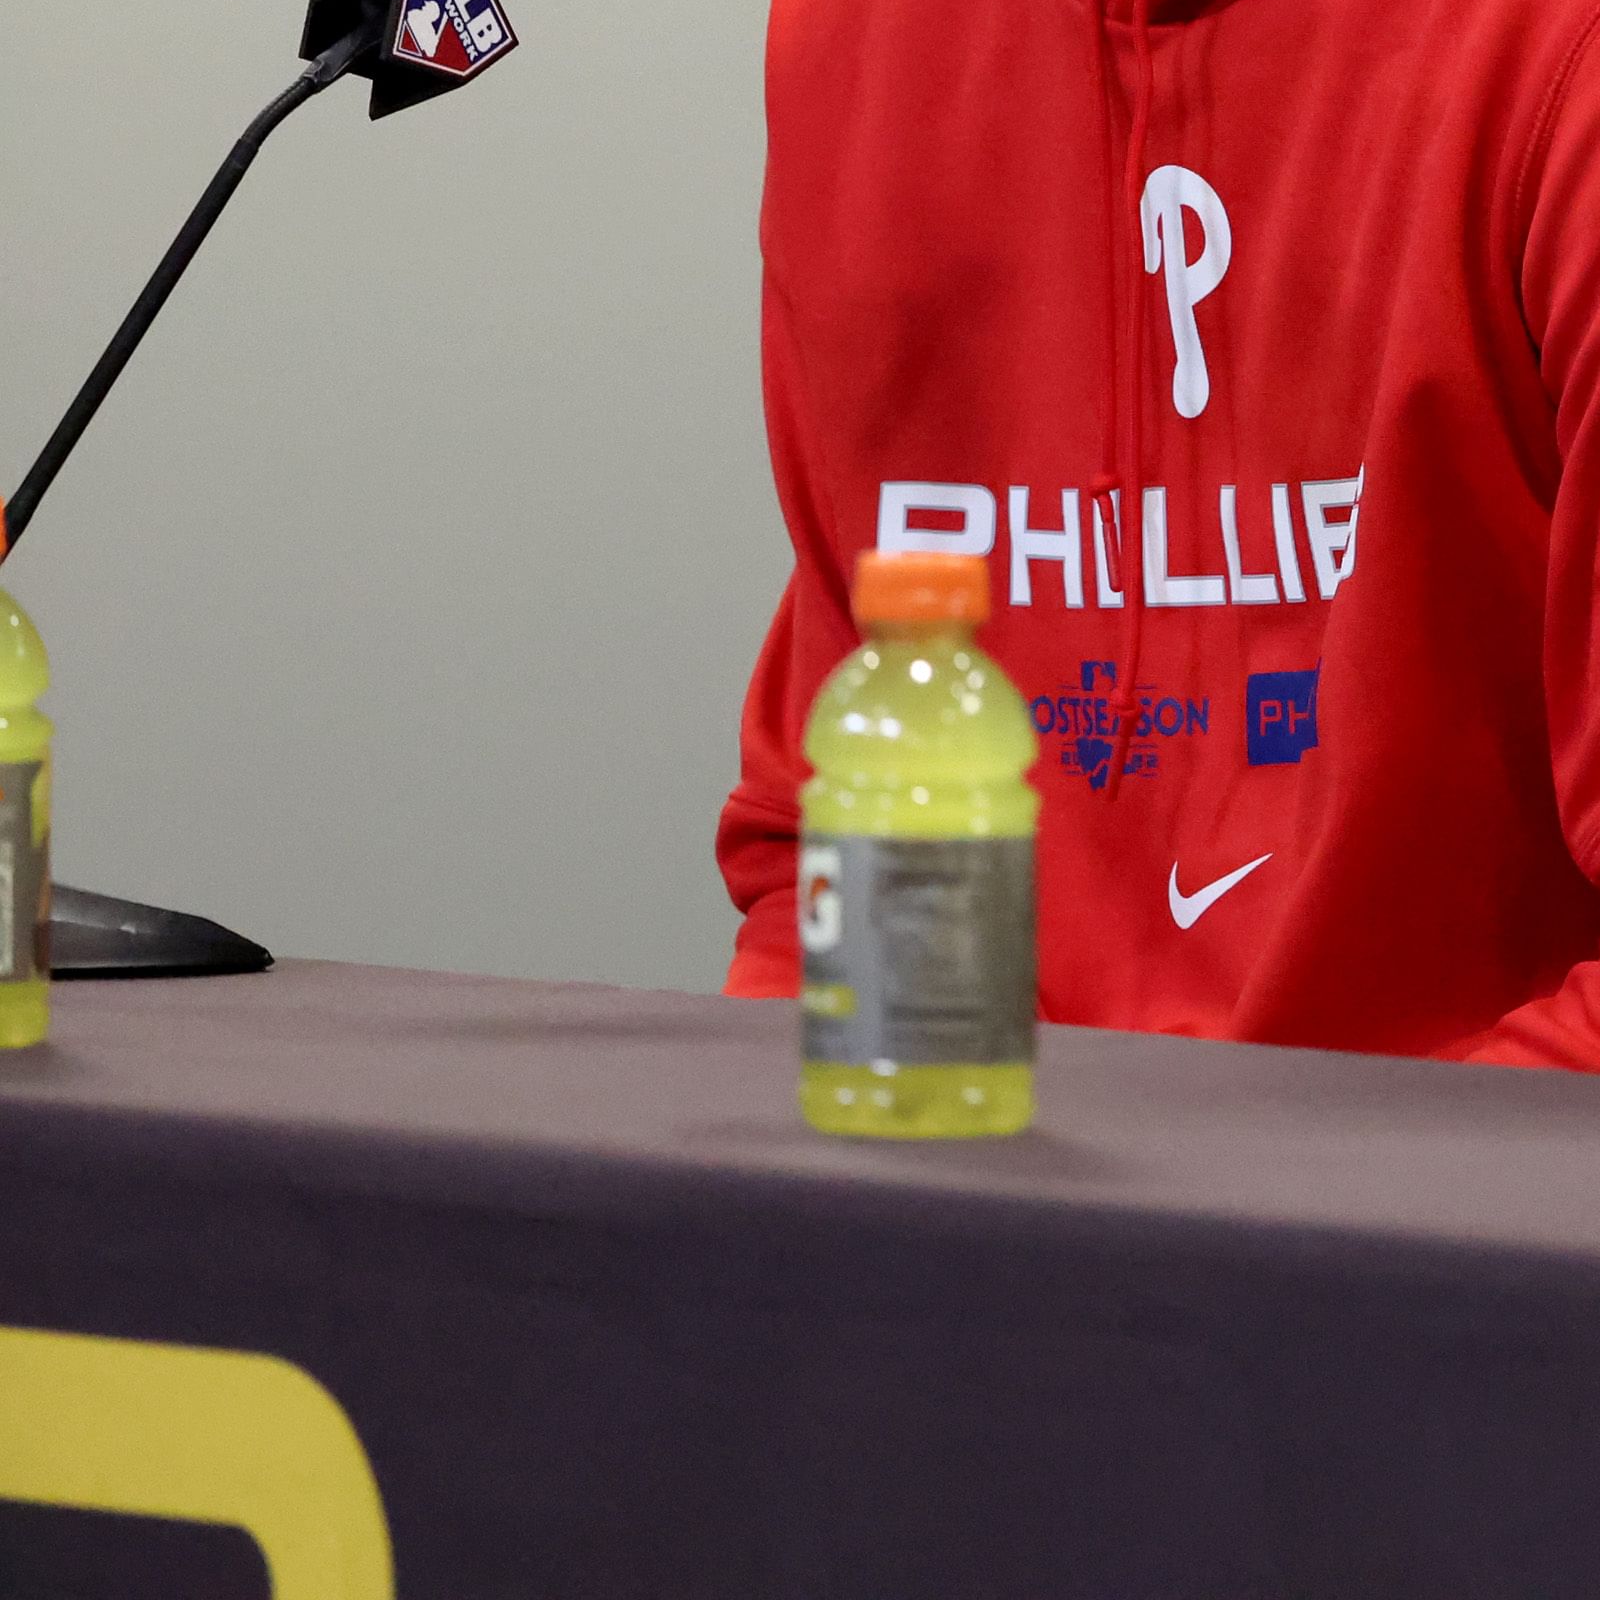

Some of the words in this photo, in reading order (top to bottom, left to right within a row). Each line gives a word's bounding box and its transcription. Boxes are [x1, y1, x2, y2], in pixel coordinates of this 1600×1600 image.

[1141, 165, 1231, 418] P
[876, 461, 1365, 608] PHILLIE
[1030, 695, 1209, 737] OSTSESON
